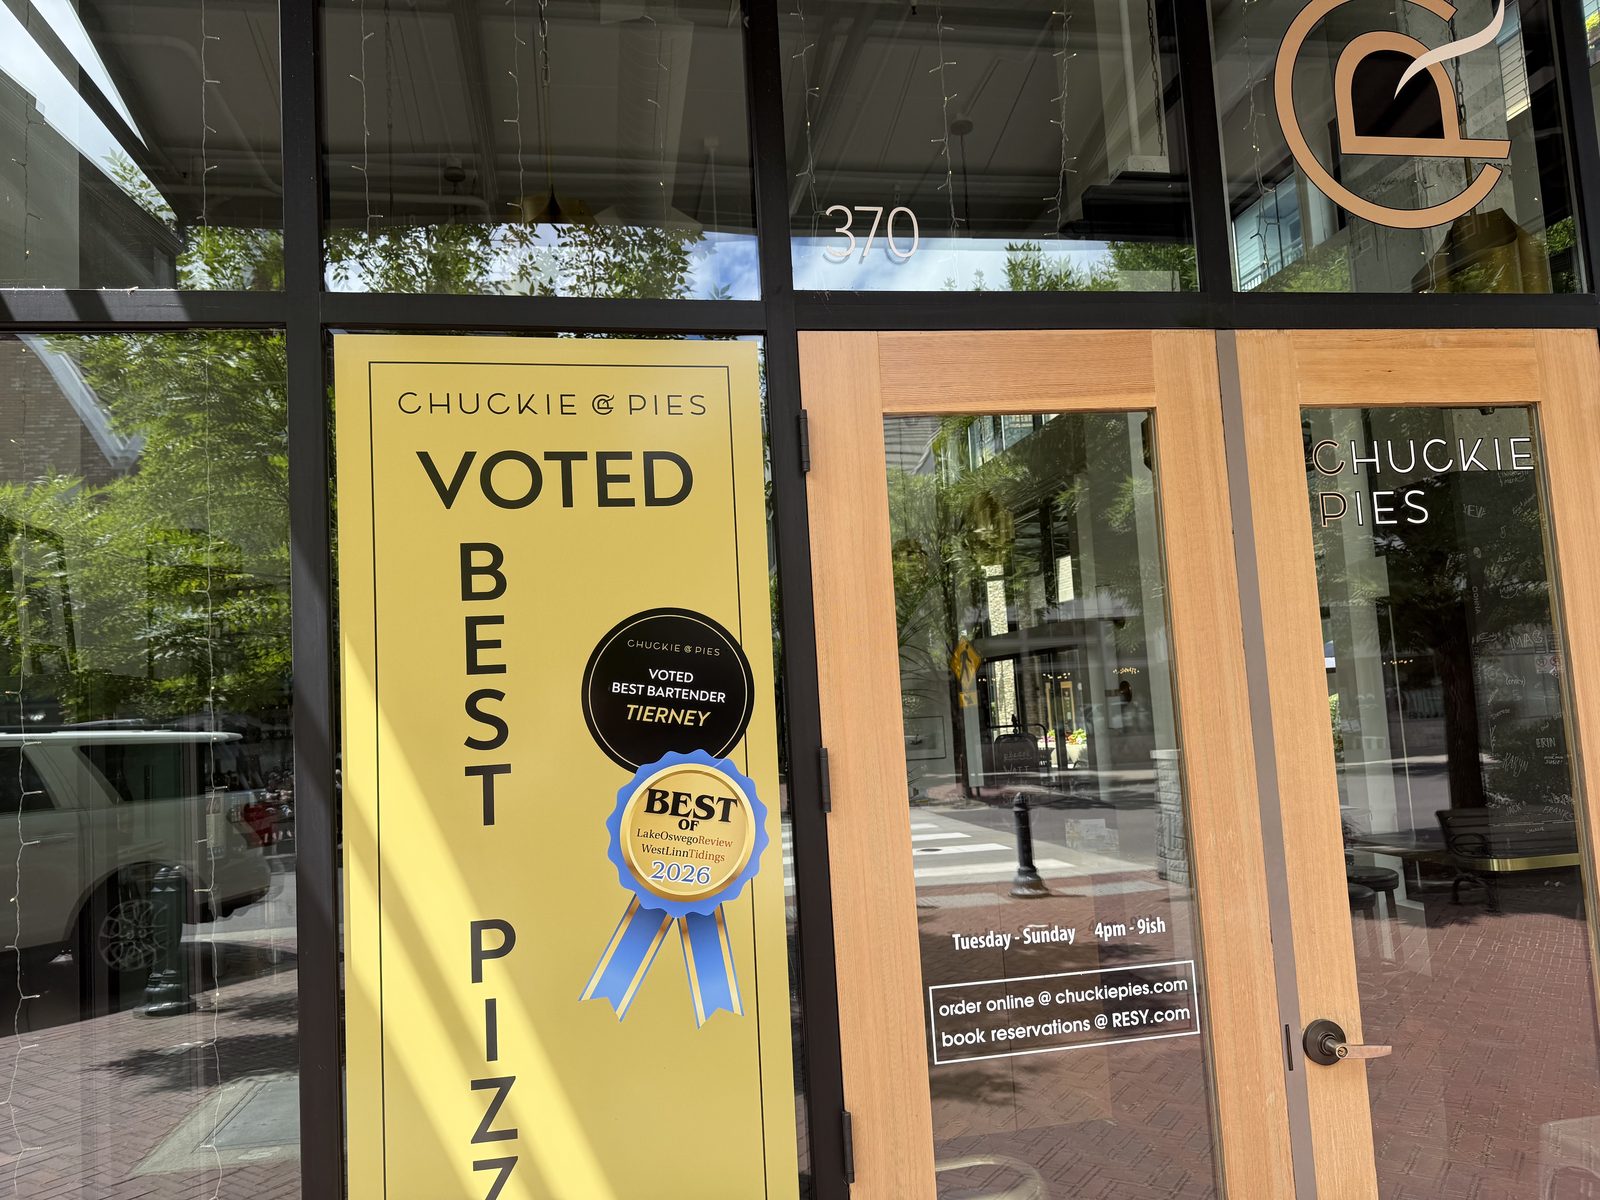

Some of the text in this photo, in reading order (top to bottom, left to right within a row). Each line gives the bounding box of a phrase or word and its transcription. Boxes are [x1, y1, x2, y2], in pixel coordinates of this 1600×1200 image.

[825, 205, 919, 258] 370
[397, 391, 577, 415] CHUCKIE
[628, 394, 706, 415] PIES
[1312, 436, 1535, 476] CHUCKIE
[415, 449, 694, 509] VOTED
[1319, 490, 1429, 528] PIES
[627, 639, 681, 652] CHUCKIE
[695, 646, 721, 657] PIES
[459, 542, 512, 826] BEST
[611, 682, 726, 704] BEST BARTENDER
[648, 668, 694, 683] VOTED
[626, 703, 711, 727] TIERNEY
[643, 788, 738, 823] BEST
[678, 818, 700, 832] OF
[650, 860, 711, 885] 2026
[952, 930, 1012, 951] Tuesday
[1023, 925, 1076, 945] Sunday
[1094, 920, 1126, 941] 4pm
[1137, 916, 1166, 935] 9ish
[938, 977, 1188, 1017] order online @ chuckiepies.com
[941, 1007, 1191, 1048] book reservations @ RESY.com
